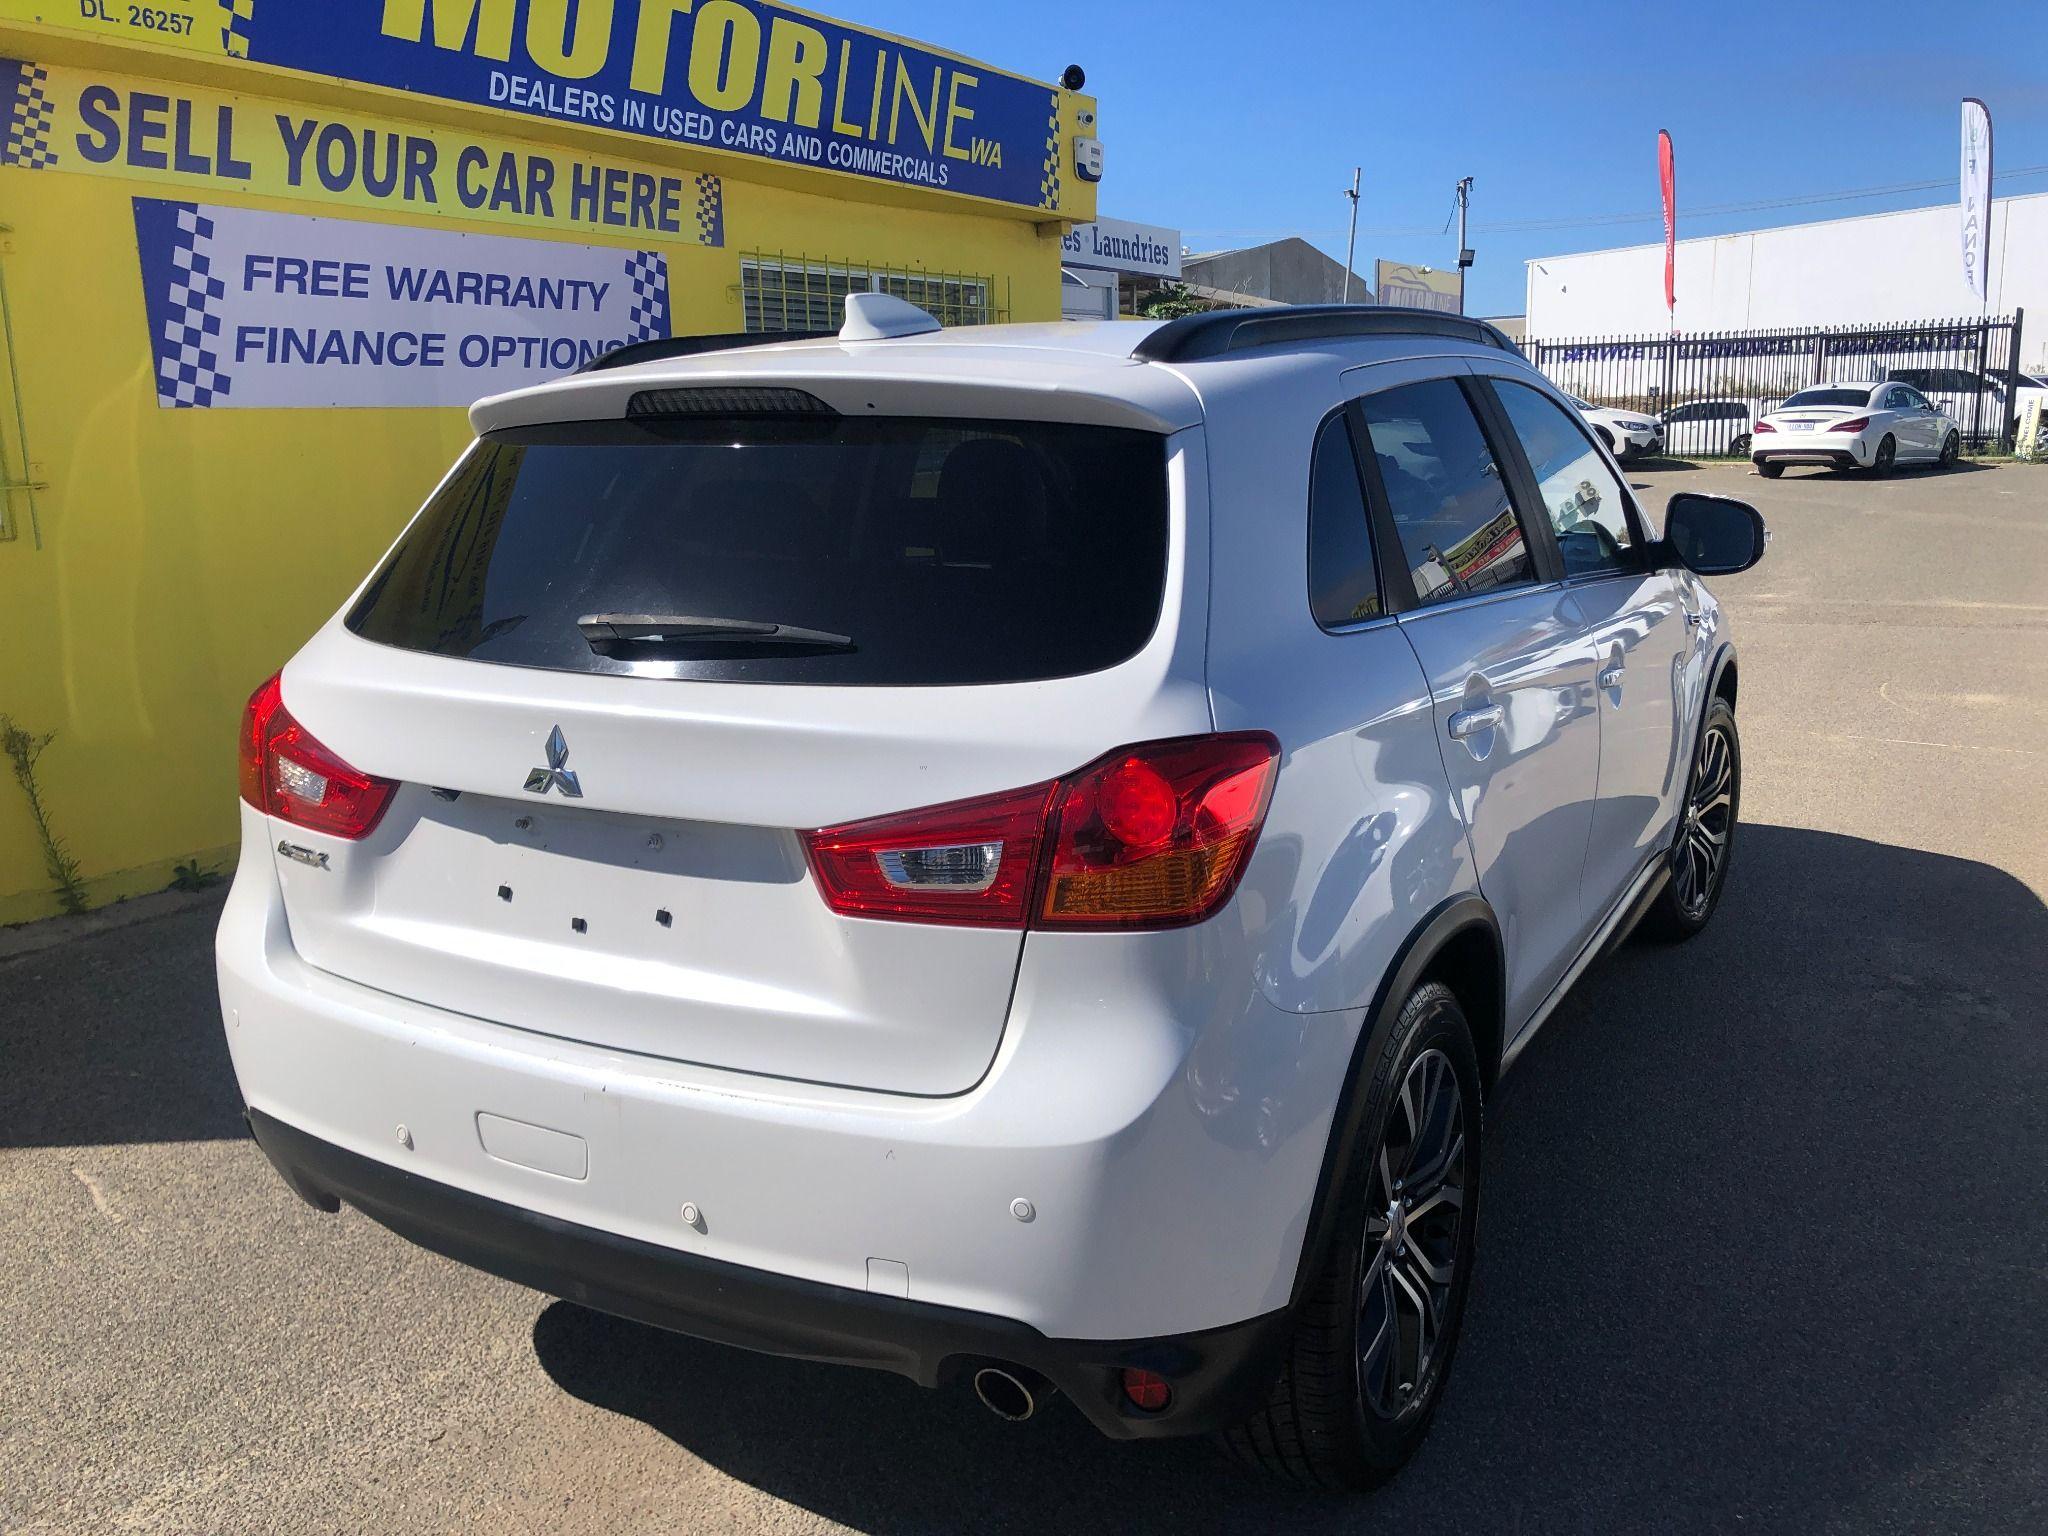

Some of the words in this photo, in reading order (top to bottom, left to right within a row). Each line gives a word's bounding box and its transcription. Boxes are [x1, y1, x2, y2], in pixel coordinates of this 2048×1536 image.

[128, 5, 194, 36] 26257
[489, 71, 615, 122] DEALERS
[622, 98, 646, 129] IN
[653, 105, 714, 141] USED
[720, 119, 777, 153] CARS
[781, 132, 822, 162] AND
[827, 141, 948, 186] COMMERCIALS
[76, 85, 252, 181] SELL
[275, 112, 438, 204] YOUR
[456, 145, 555, 218] CAR
[570, 163, 682, 233] HERE
[971, 136, 1002, 169] WA
[1092, 226, 1169, 266] Laundries
[243, 254, 371, 299] FREE
[385, 265, 610, 312] WARRANTY
[235, 325, 446, 367] FINANCE
